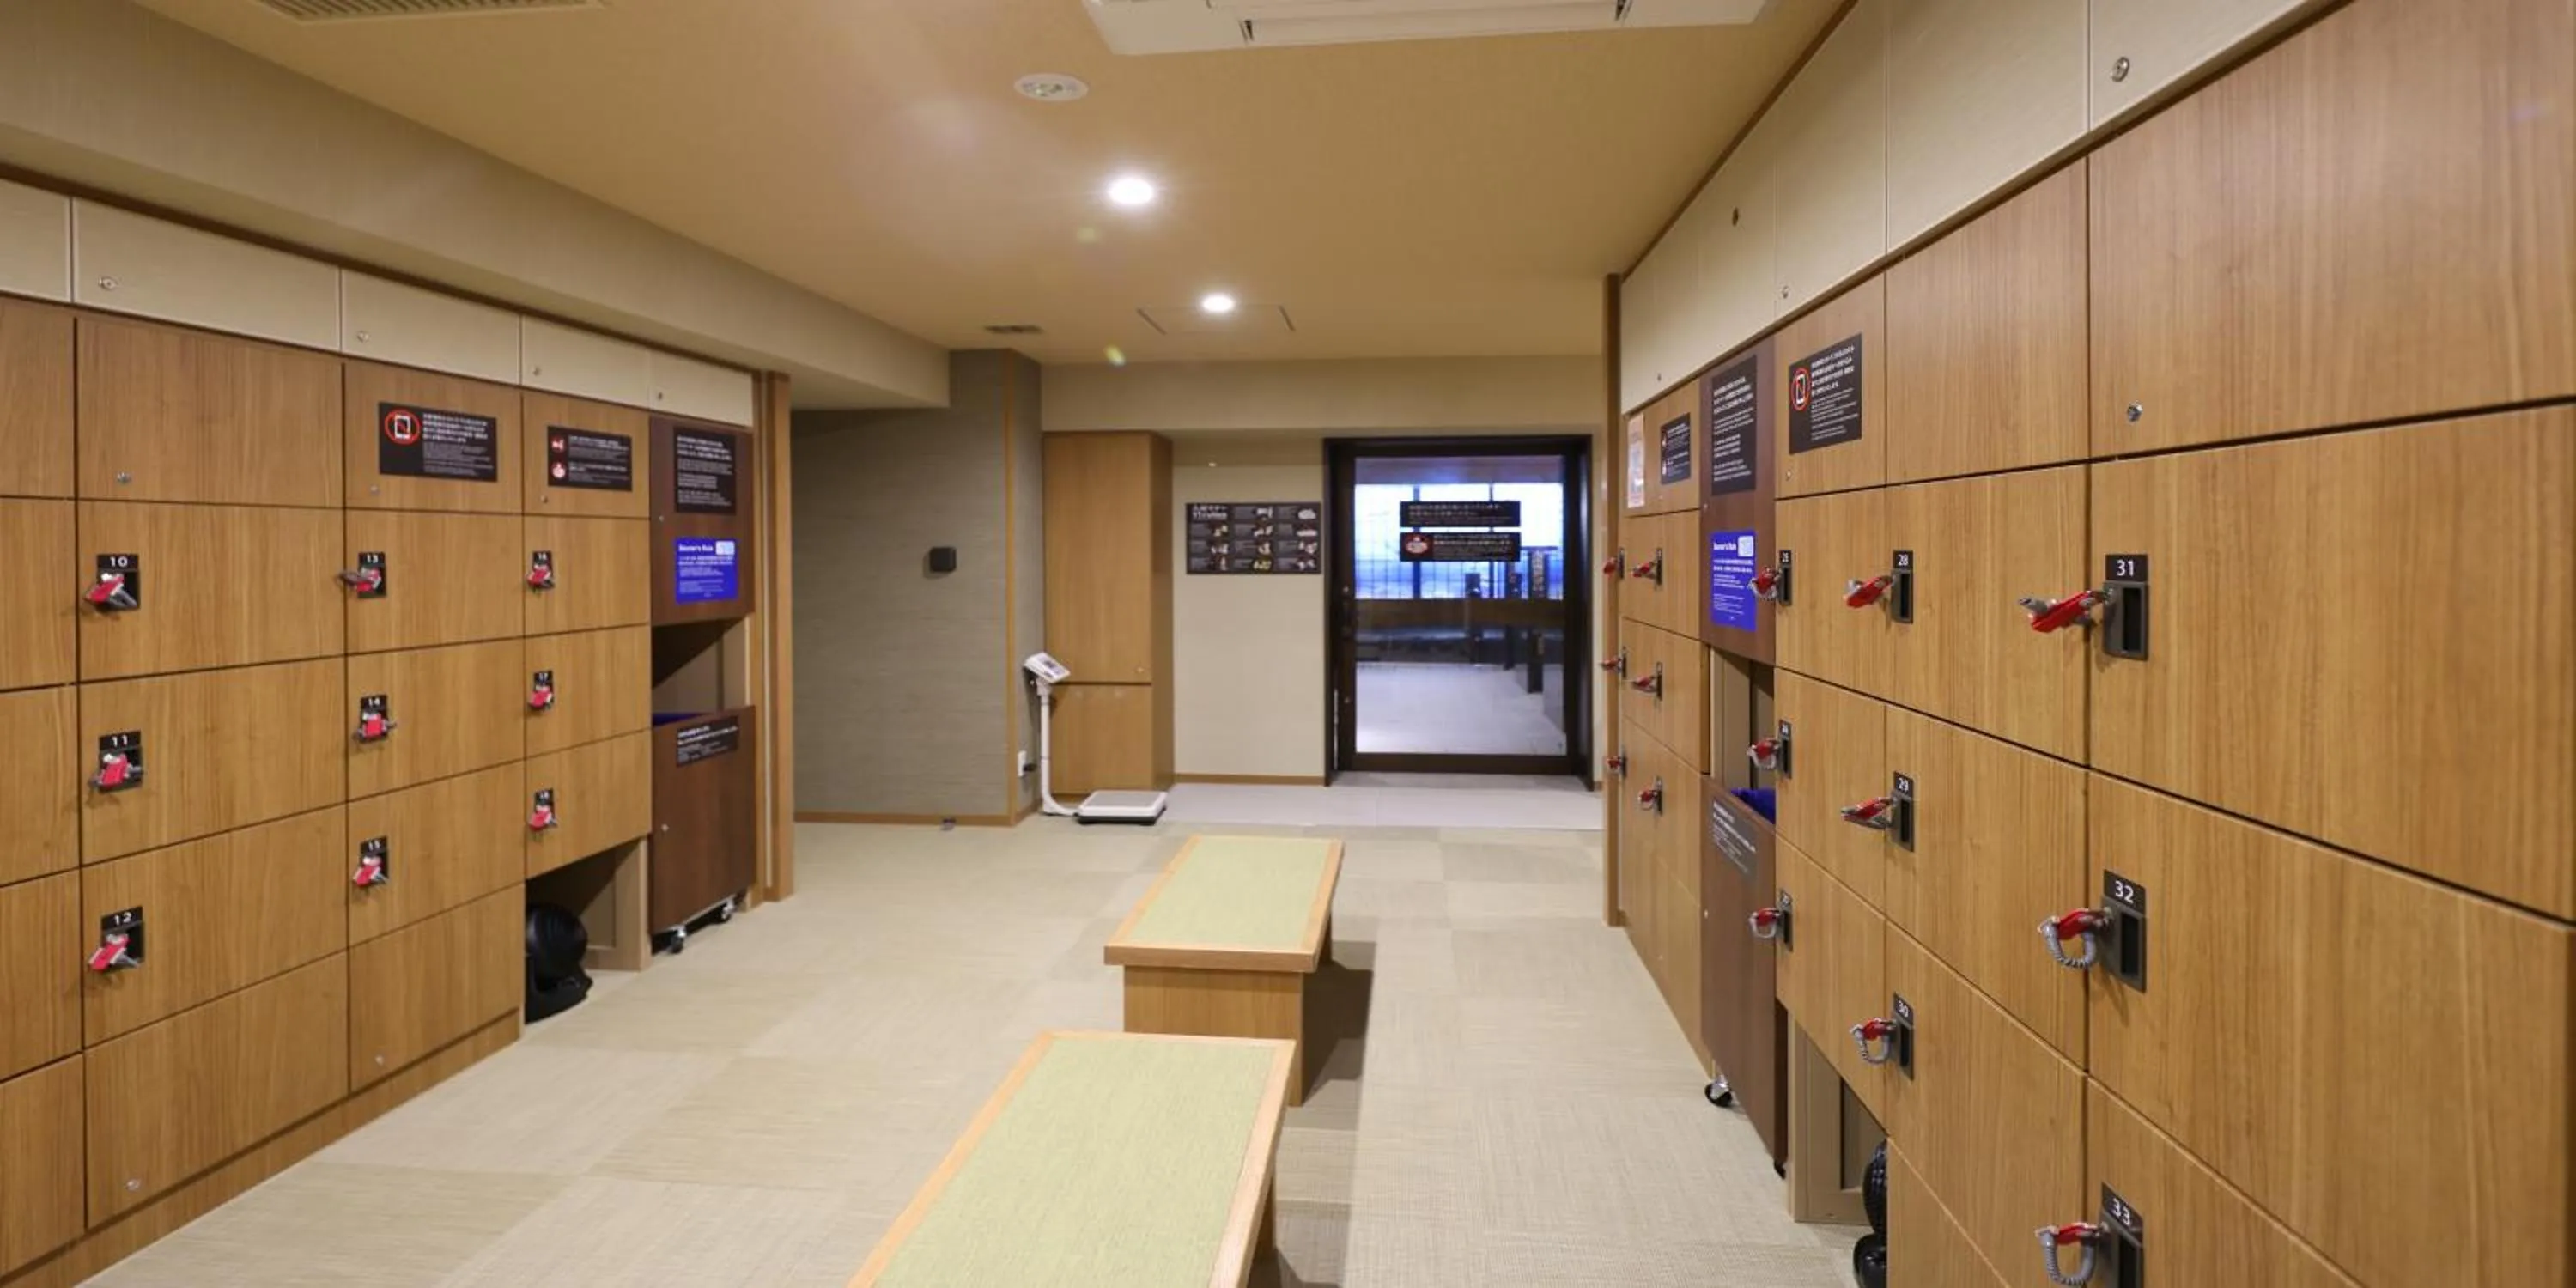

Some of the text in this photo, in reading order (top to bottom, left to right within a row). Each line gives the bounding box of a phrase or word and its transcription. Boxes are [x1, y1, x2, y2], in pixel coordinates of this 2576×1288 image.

[110, 556, 128, 567] 10
[1898, 554, 1909, 567] 28
[2117, 559, 2135, 577] 31
[112, 735, 128, 747] 11
[1899, 777, 1909, 792] 29
[368, 841, 380, 850] 15
[2115, 880, 2134, 904] 32
[115, 911, 131, 925] 12
[1899, 999, 1909, 1018] 30
[2112, 1197, 2131, 1227] 33
